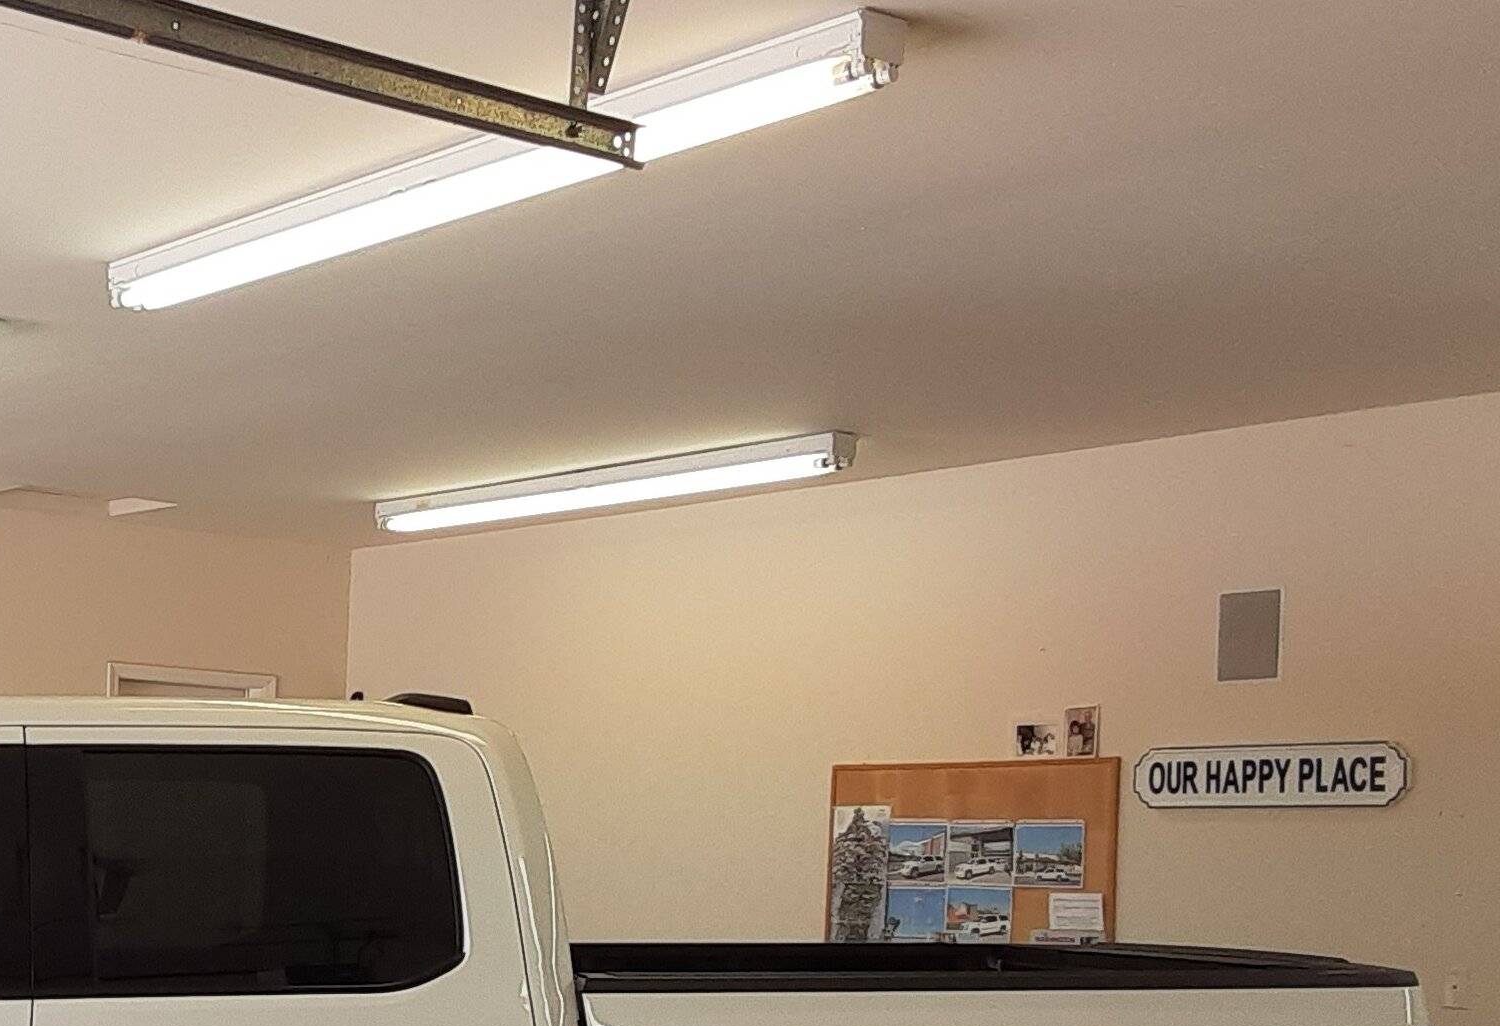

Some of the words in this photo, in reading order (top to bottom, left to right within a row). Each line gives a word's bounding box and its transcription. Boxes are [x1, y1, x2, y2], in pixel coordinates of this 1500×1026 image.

[1149, 761, 1198, 794] OUR
[1205, 759, 1291, 794] HAPPY
[1298, 756, 1387, 793] PLACE
